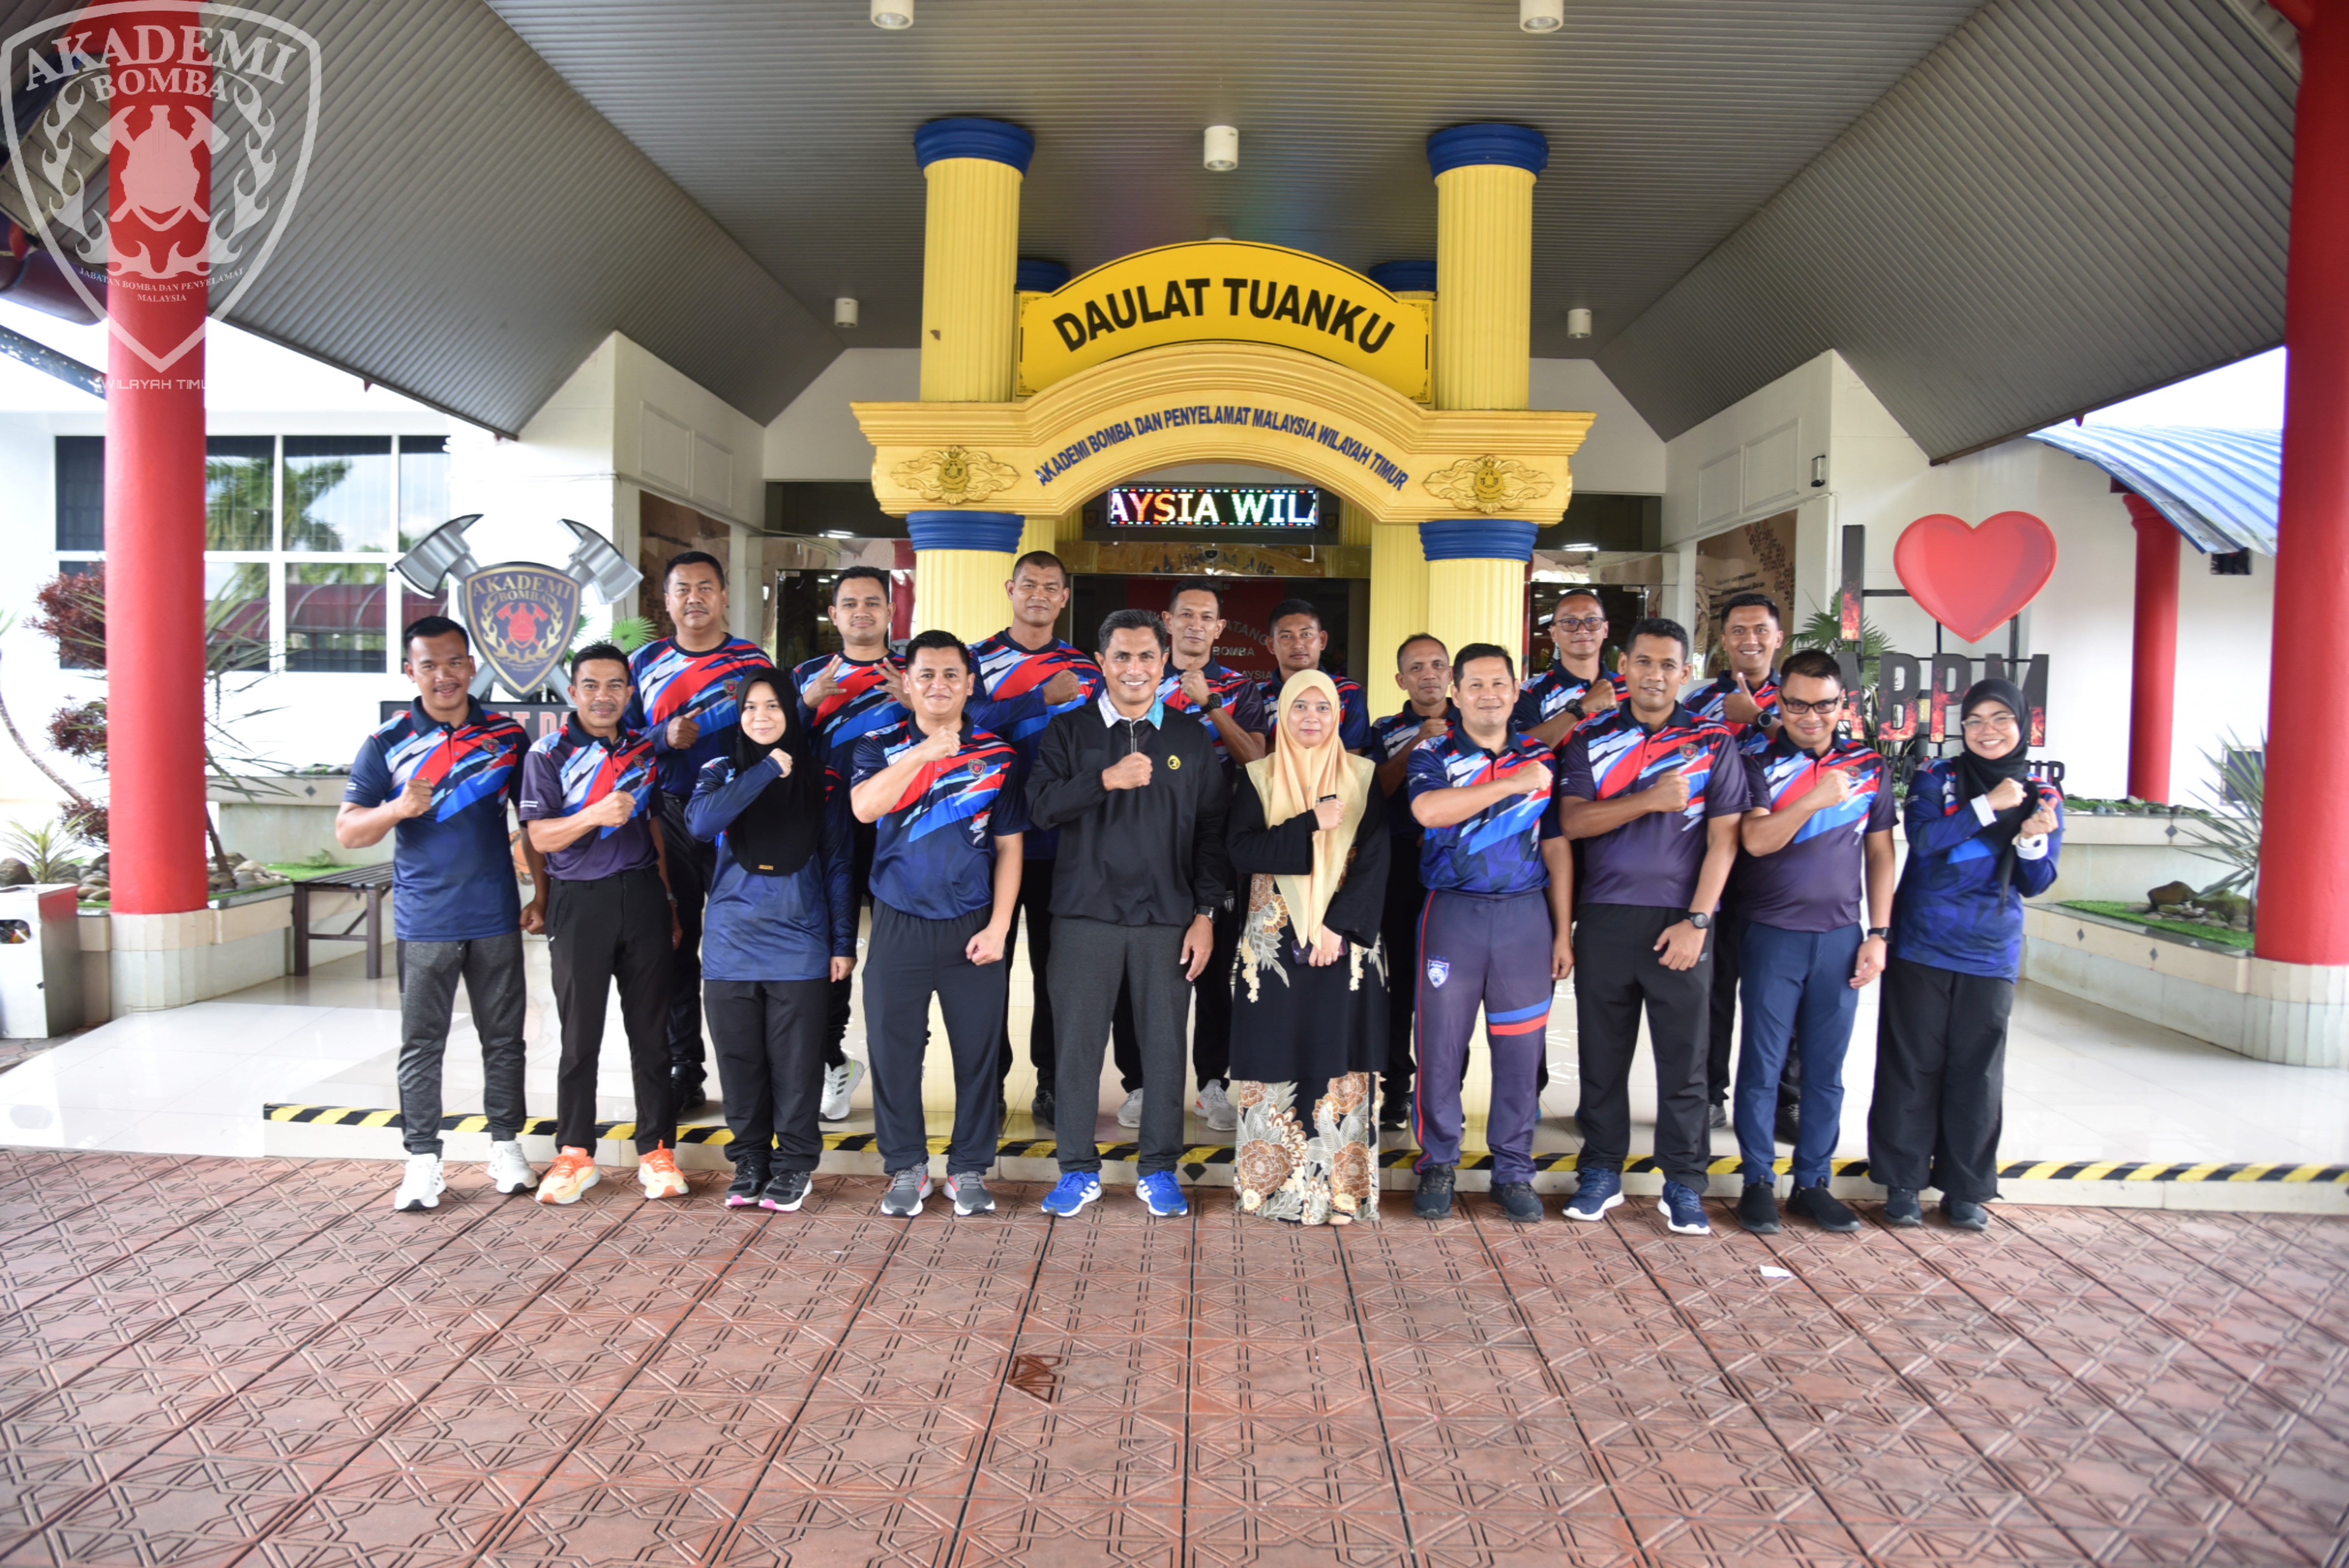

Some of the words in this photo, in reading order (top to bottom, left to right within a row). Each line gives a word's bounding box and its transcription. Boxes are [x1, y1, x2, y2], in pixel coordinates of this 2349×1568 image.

[1052, 278, 1211, 353] DAULAT
[1223, 277, 1395, 354] TUANKU
[1035, 439, 1091, 486] AKADEMI
[1087, 421, 1136, 453] BOMBA
[1134, 413, 1163, 436] DAN
[1164, 406, 1251, 428] PENYELAMAT
[1252, 408, 1317, 440] MALAYSIA
[1317, 425, 1373, 465] WILAYAH
[1369, 452, 1409, 492] TIMUR
[1111, 493, 1220, 522] AYSIA
[472, 574, 572, 600] AKADEMI
[498, 590, 547, 604] BOMBA
[1226, 620, 1268, 646] ATANG
[1212, 646, 1255, 657] BOMBA
[1242, 670, 1273, 680] AYSIA
